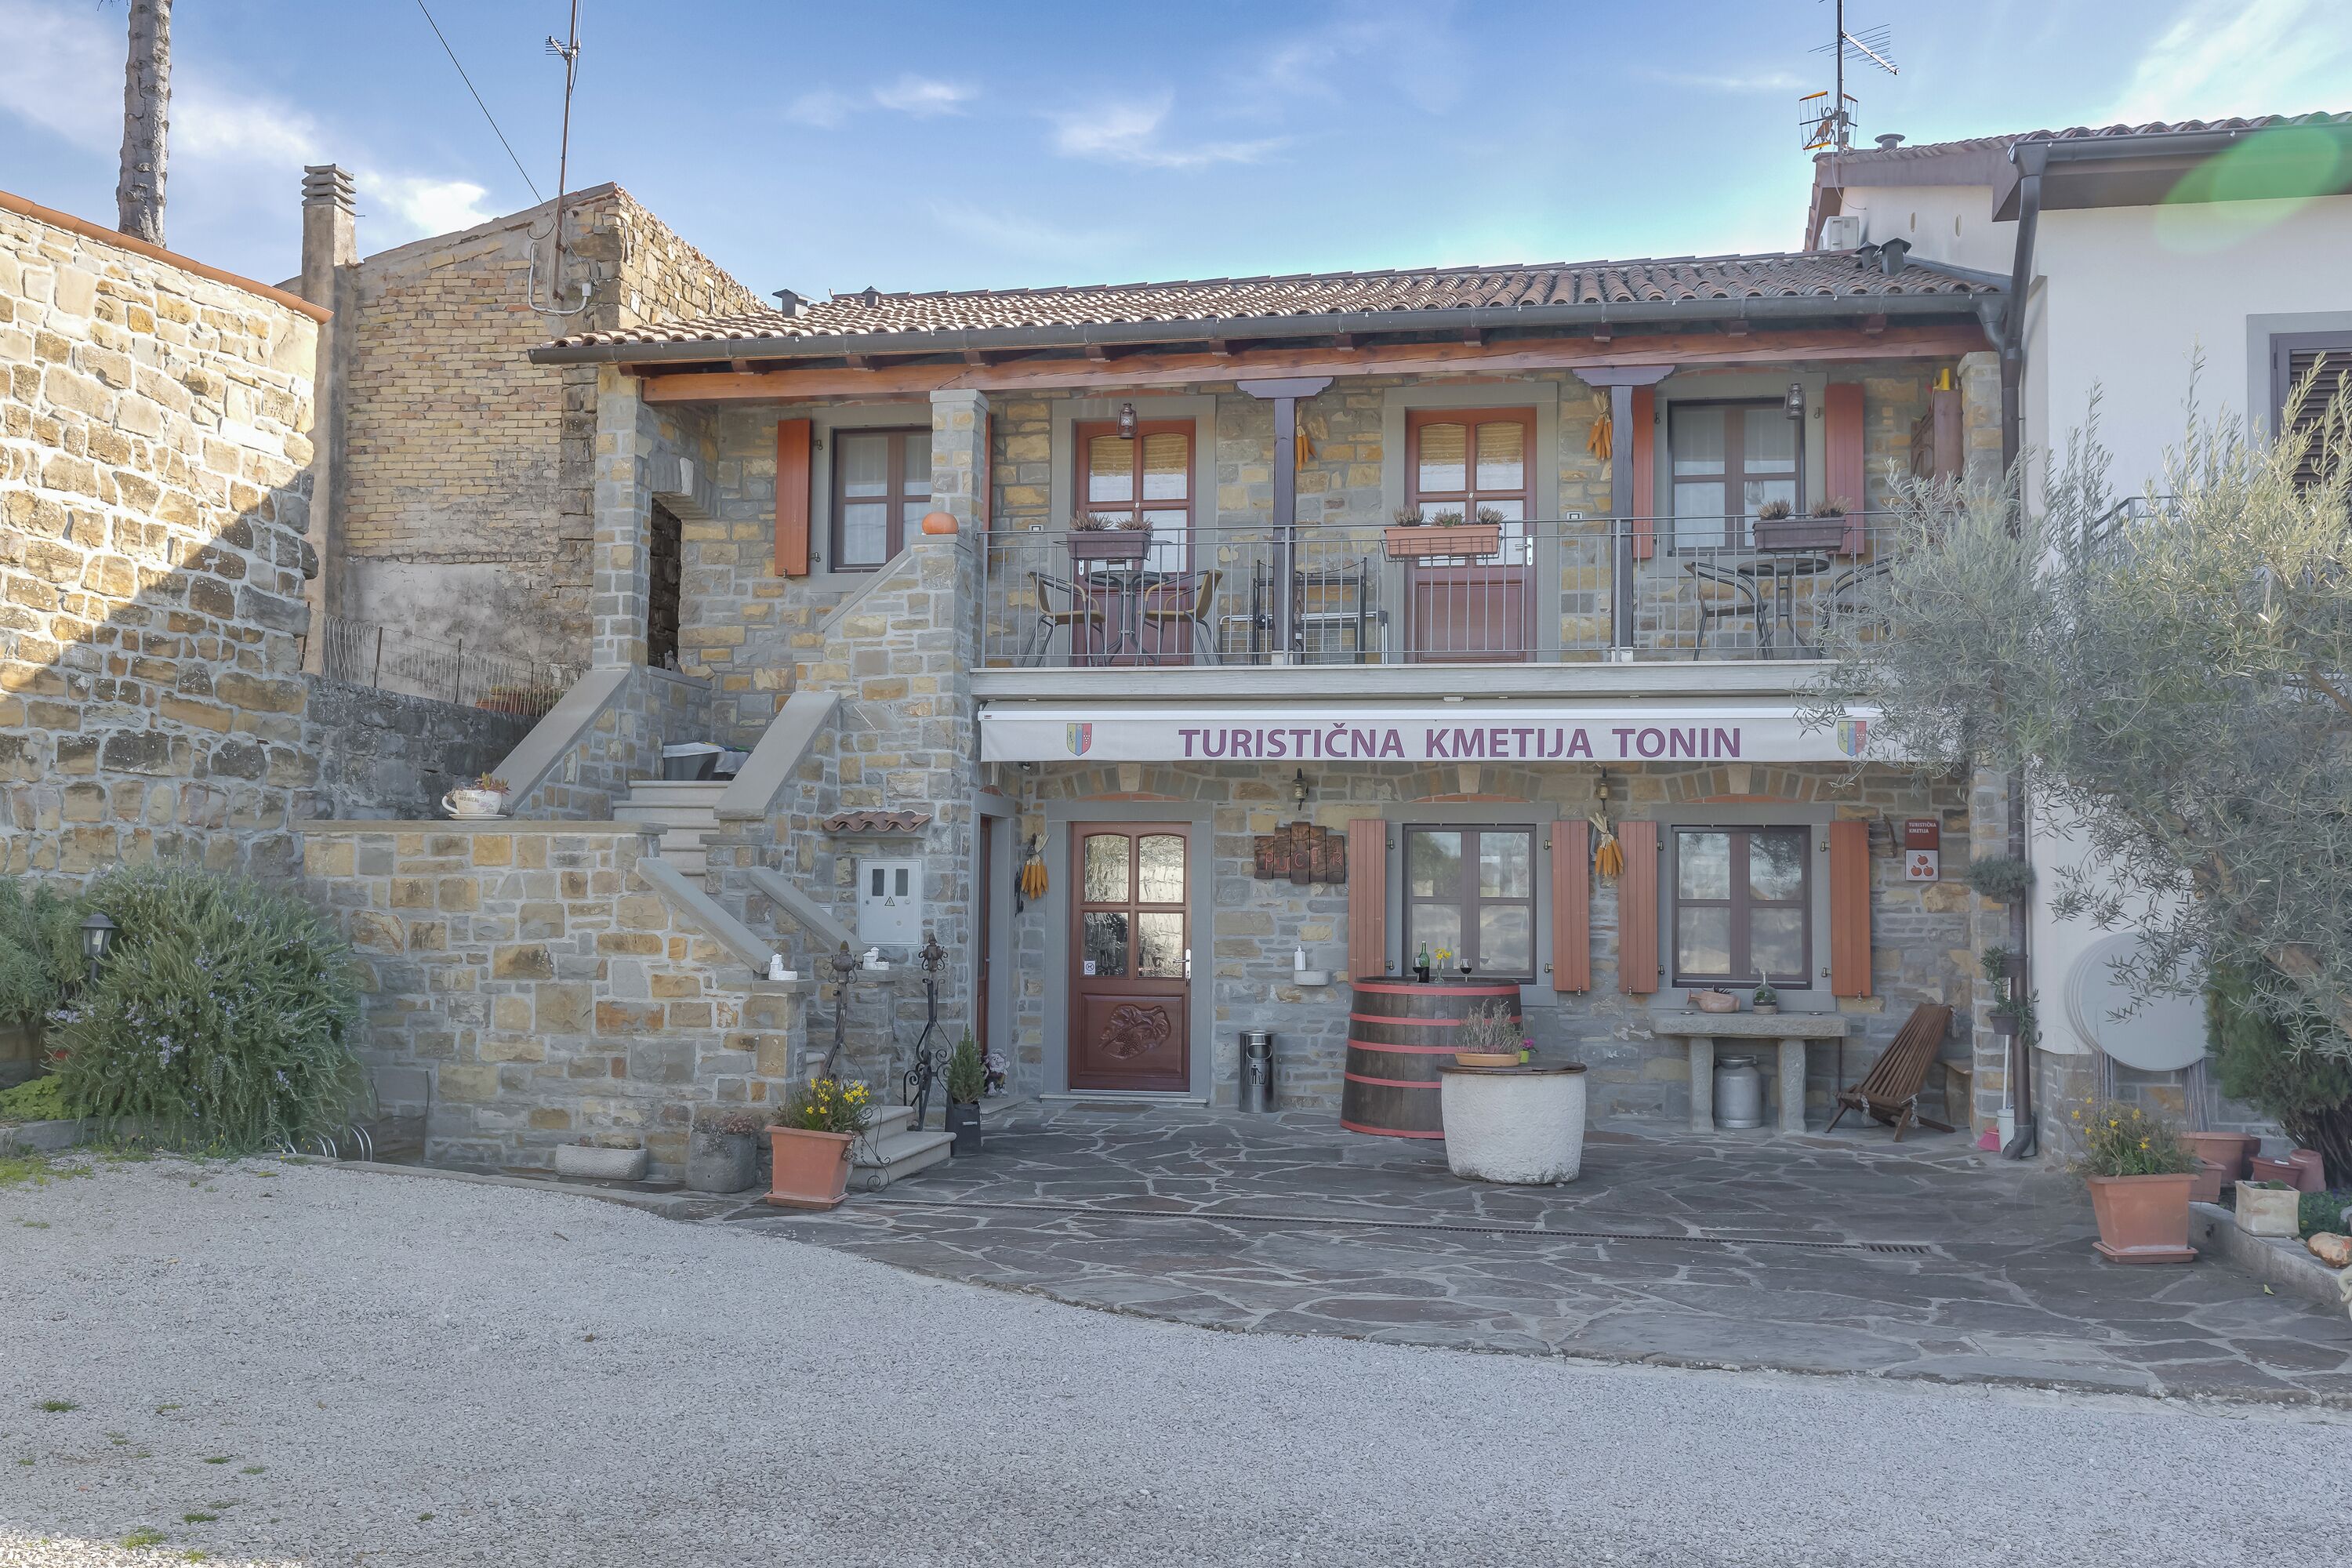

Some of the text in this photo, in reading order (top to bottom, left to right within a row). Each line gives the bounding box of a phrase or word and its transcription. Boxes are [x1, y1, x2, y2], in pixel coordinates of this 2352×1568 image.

[1178, 723, 1741, 758] TURISTIČNA KMETIJA TONIN
